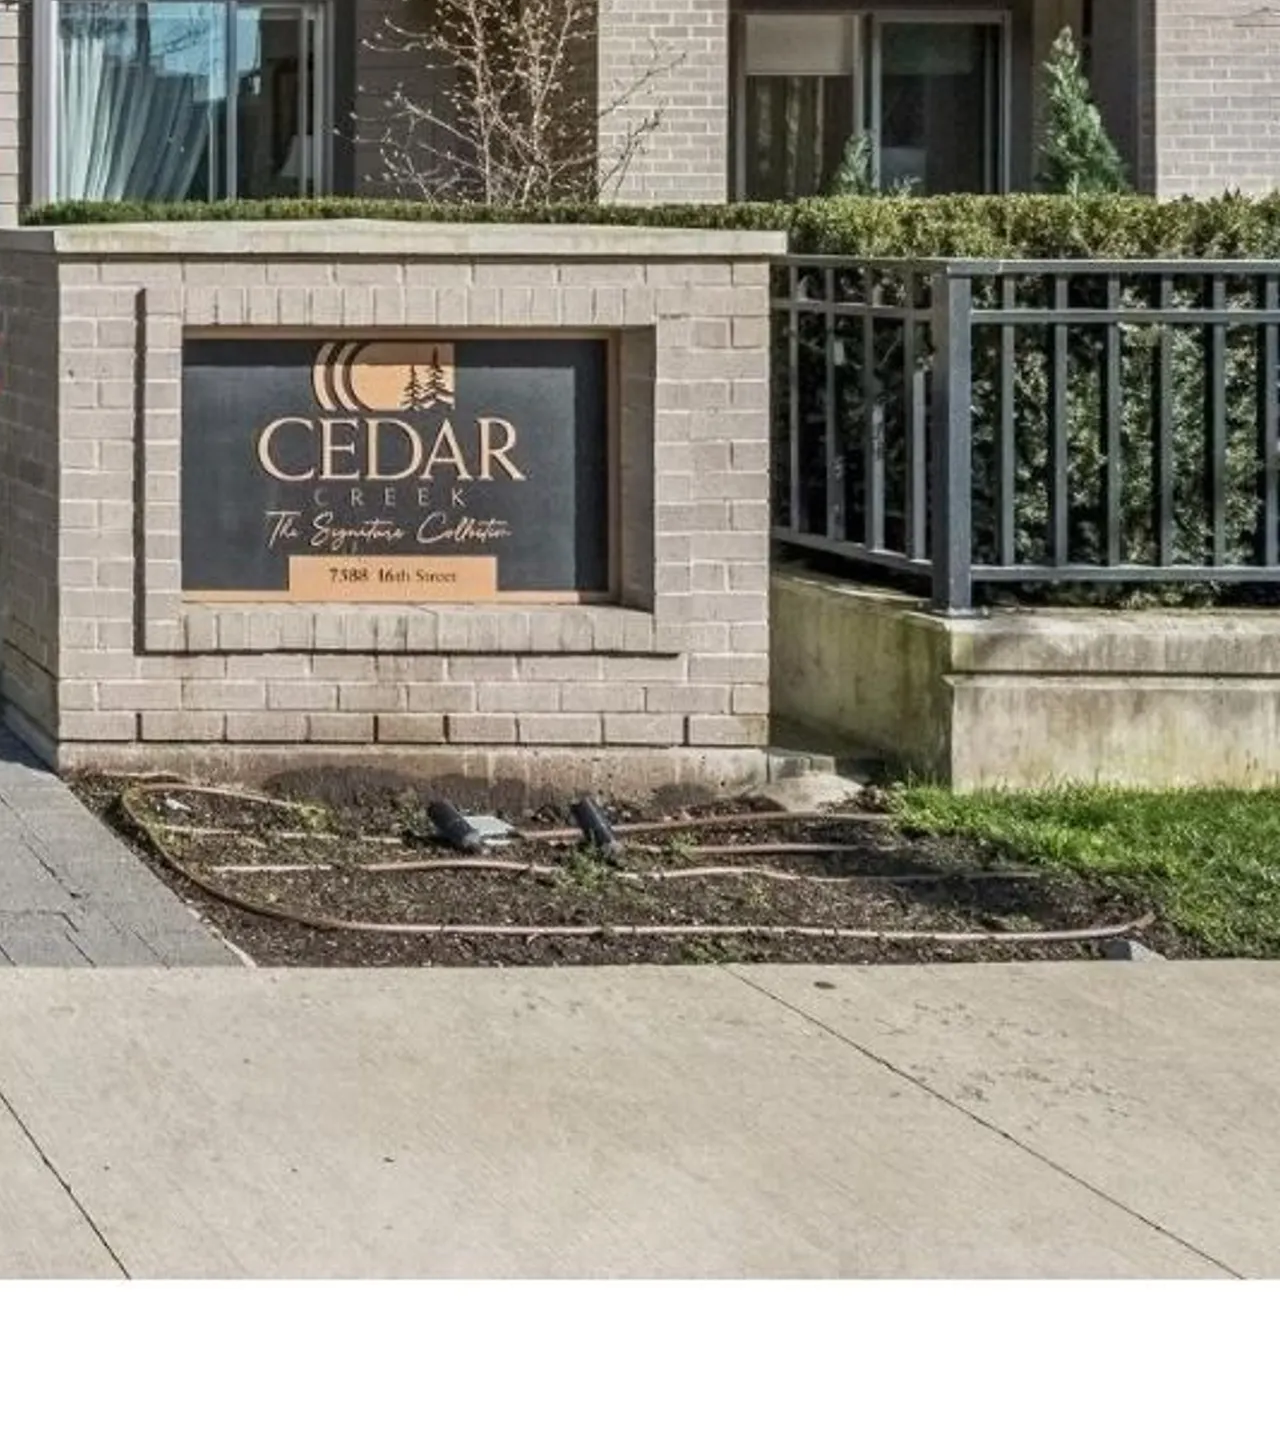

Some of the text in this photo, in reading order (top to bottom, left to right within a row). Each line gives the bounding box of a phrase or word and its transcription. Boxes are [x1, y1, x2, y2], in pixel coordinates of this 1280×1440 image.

[257, 417, 527, 481] CEDAR
[313, 487, 467, 507] CREEK
[265, 511, 513, 551] The Signature Collection
[377, 568, 411, 584] 16th
[415, 568, 458, 584] Street
